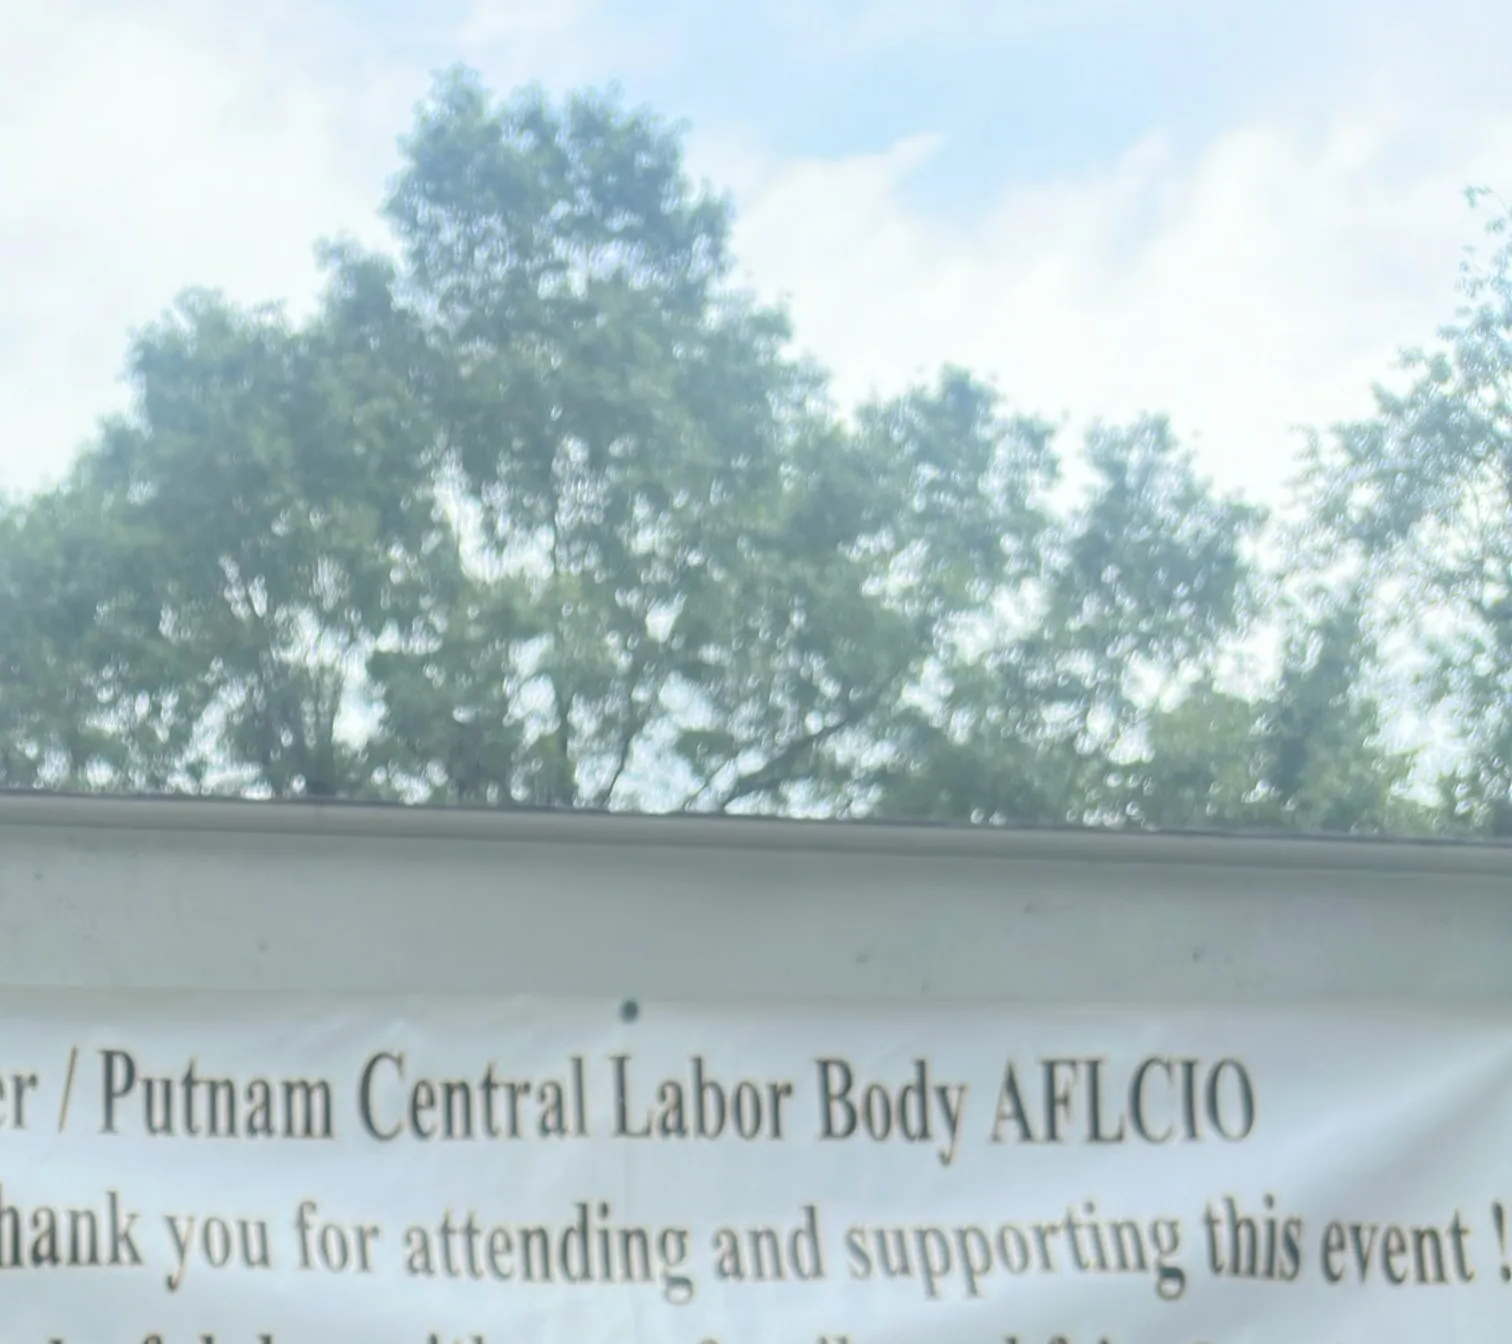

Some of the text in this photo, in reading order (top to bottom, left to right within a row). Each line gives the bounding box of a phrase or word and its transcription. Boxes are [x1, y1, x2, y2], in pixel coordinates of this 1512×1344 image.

[58, 1046, 79, 1134] /
[98, 1046, 335, 1140] Putnam
[358, 1051, 590, 1142] Central
[611, 1054, 794, 1141] Labor
[815, 1056, 968, 1167] Body
[988, 1056, 1257, 1144] AFLCIO
[163, 1214, 273, 1294] you
[294, 1201, 380, 1274] for
[404, 1201, 696, 1305] attending
[713, 1204, 829, 1281] and
[845, 1201, 1187, 1301] supporting
[1203, 1193, 1304, 1282] this
[1319, 1208, 1475, 1286] event
[1490, 1200, 1512, 1283] !
